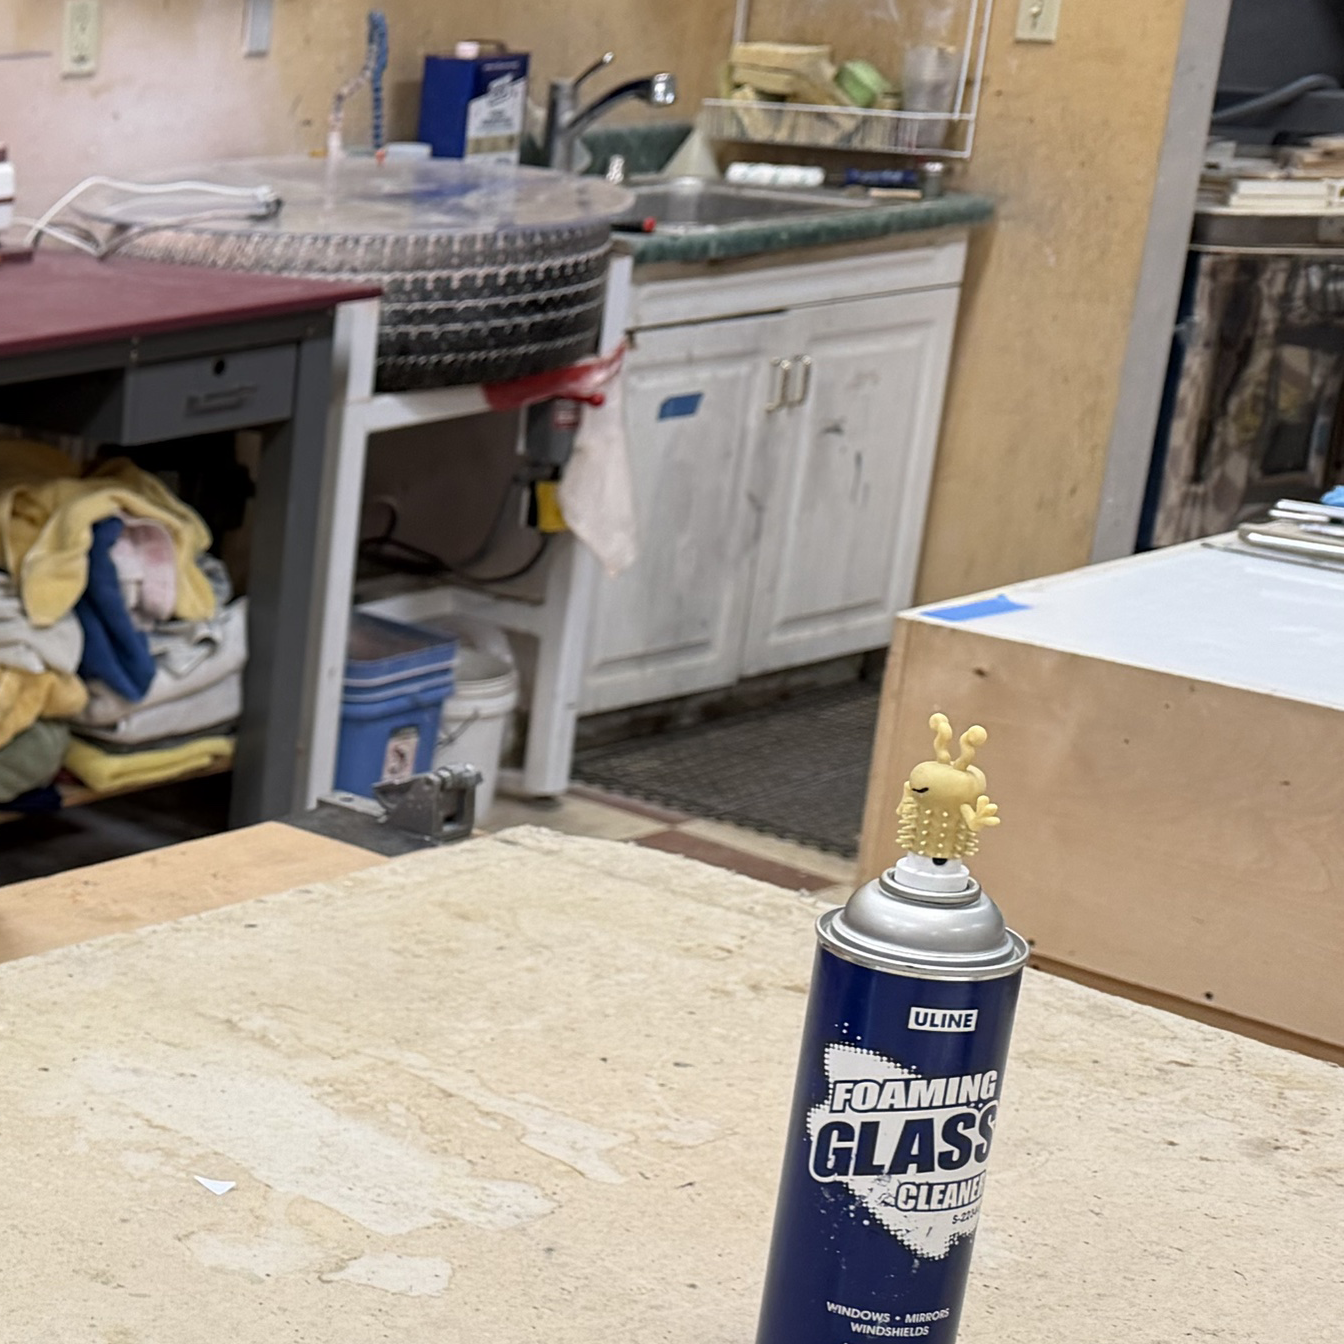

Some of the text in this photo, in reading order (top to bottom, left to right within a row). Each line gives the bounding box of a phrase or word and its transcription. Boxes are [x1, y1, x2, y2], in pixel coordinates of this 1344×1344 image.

[914, 1010, 974, 1029] ULINE
[830, 1069, 999, 1113] FOAMING
[812, 1104, 999, 1179] GLASS
[826, 1301, 950, 1324] WINDOWS MIRRORS
[850, 1321, 930, 1338] WINDSHIELDS
